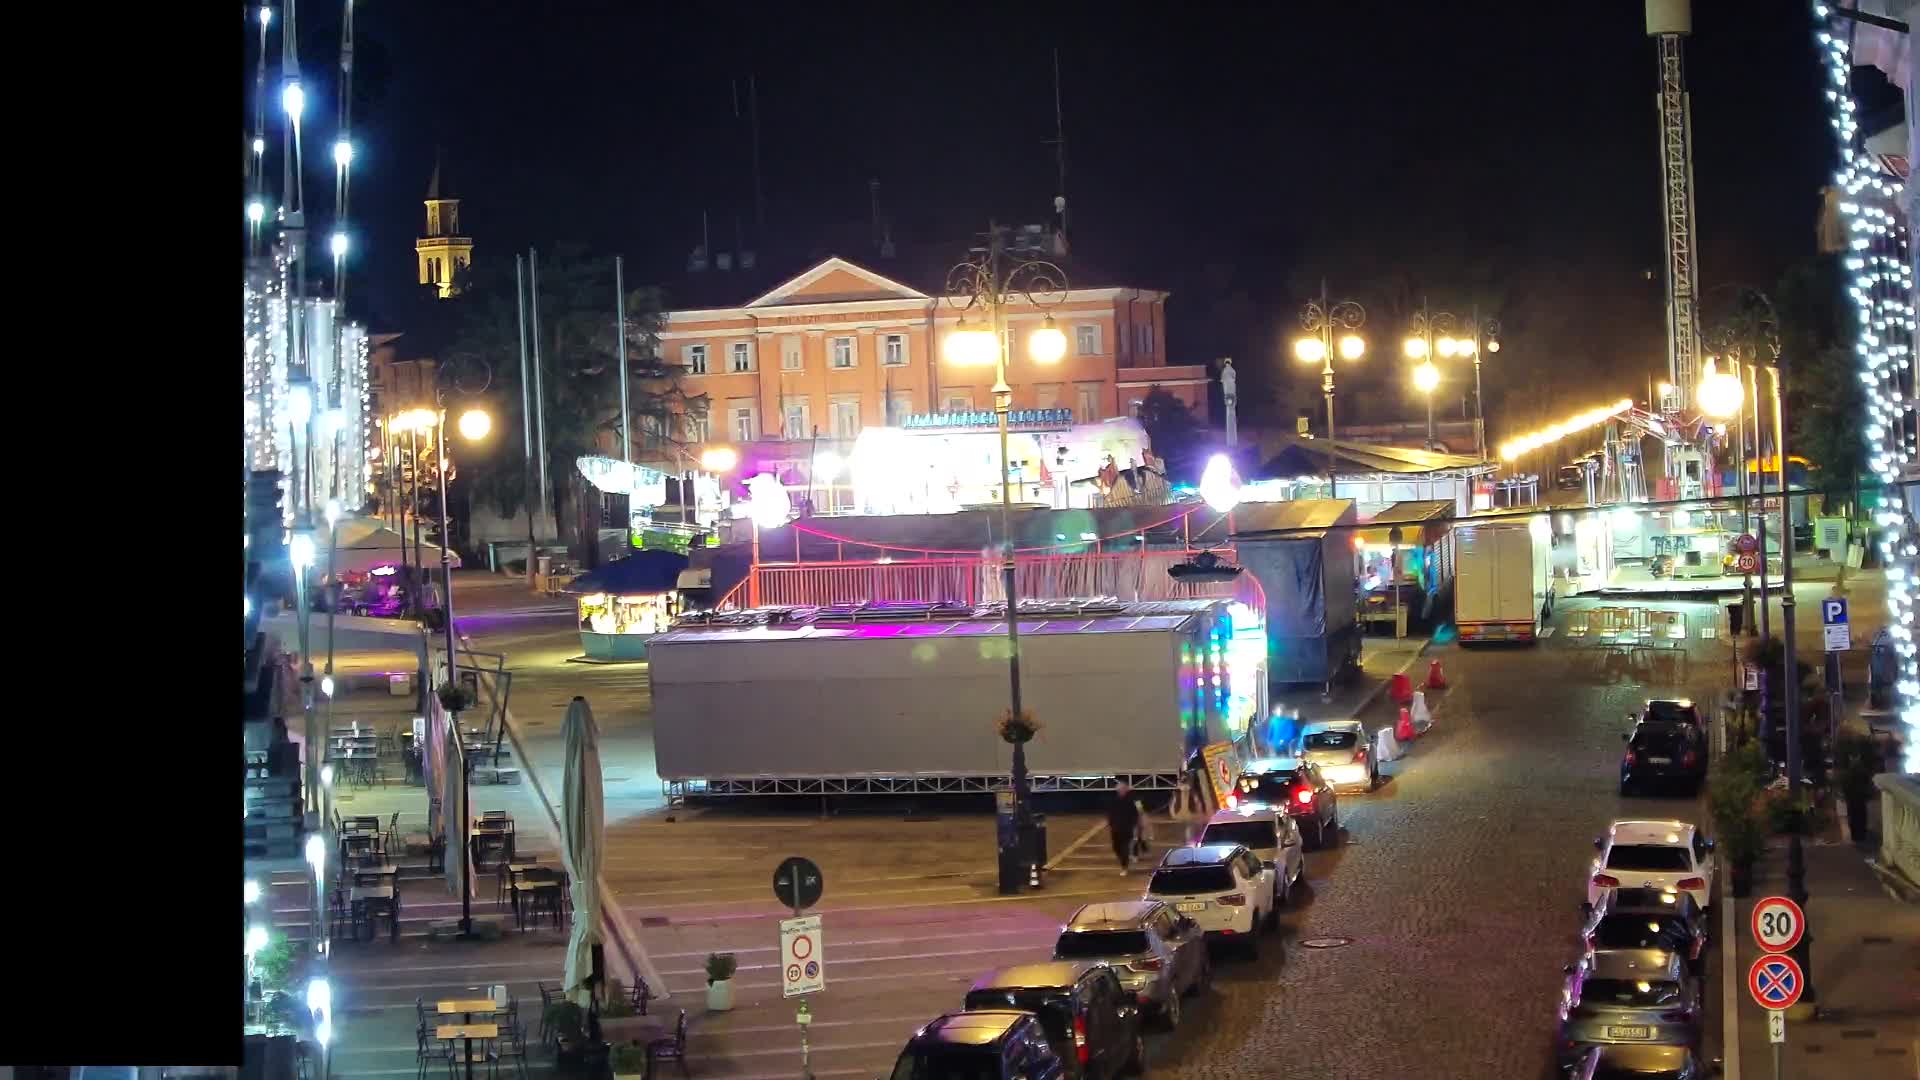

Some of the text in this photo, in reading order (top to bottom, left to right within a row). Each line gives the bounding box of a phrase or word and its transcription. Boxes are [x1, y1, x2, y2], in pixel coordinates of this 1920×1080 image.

[1742, 558, 1752, 566] 20
[1827, 602, 1842, 621] P
[1763, 912, 1791, 937] 30
